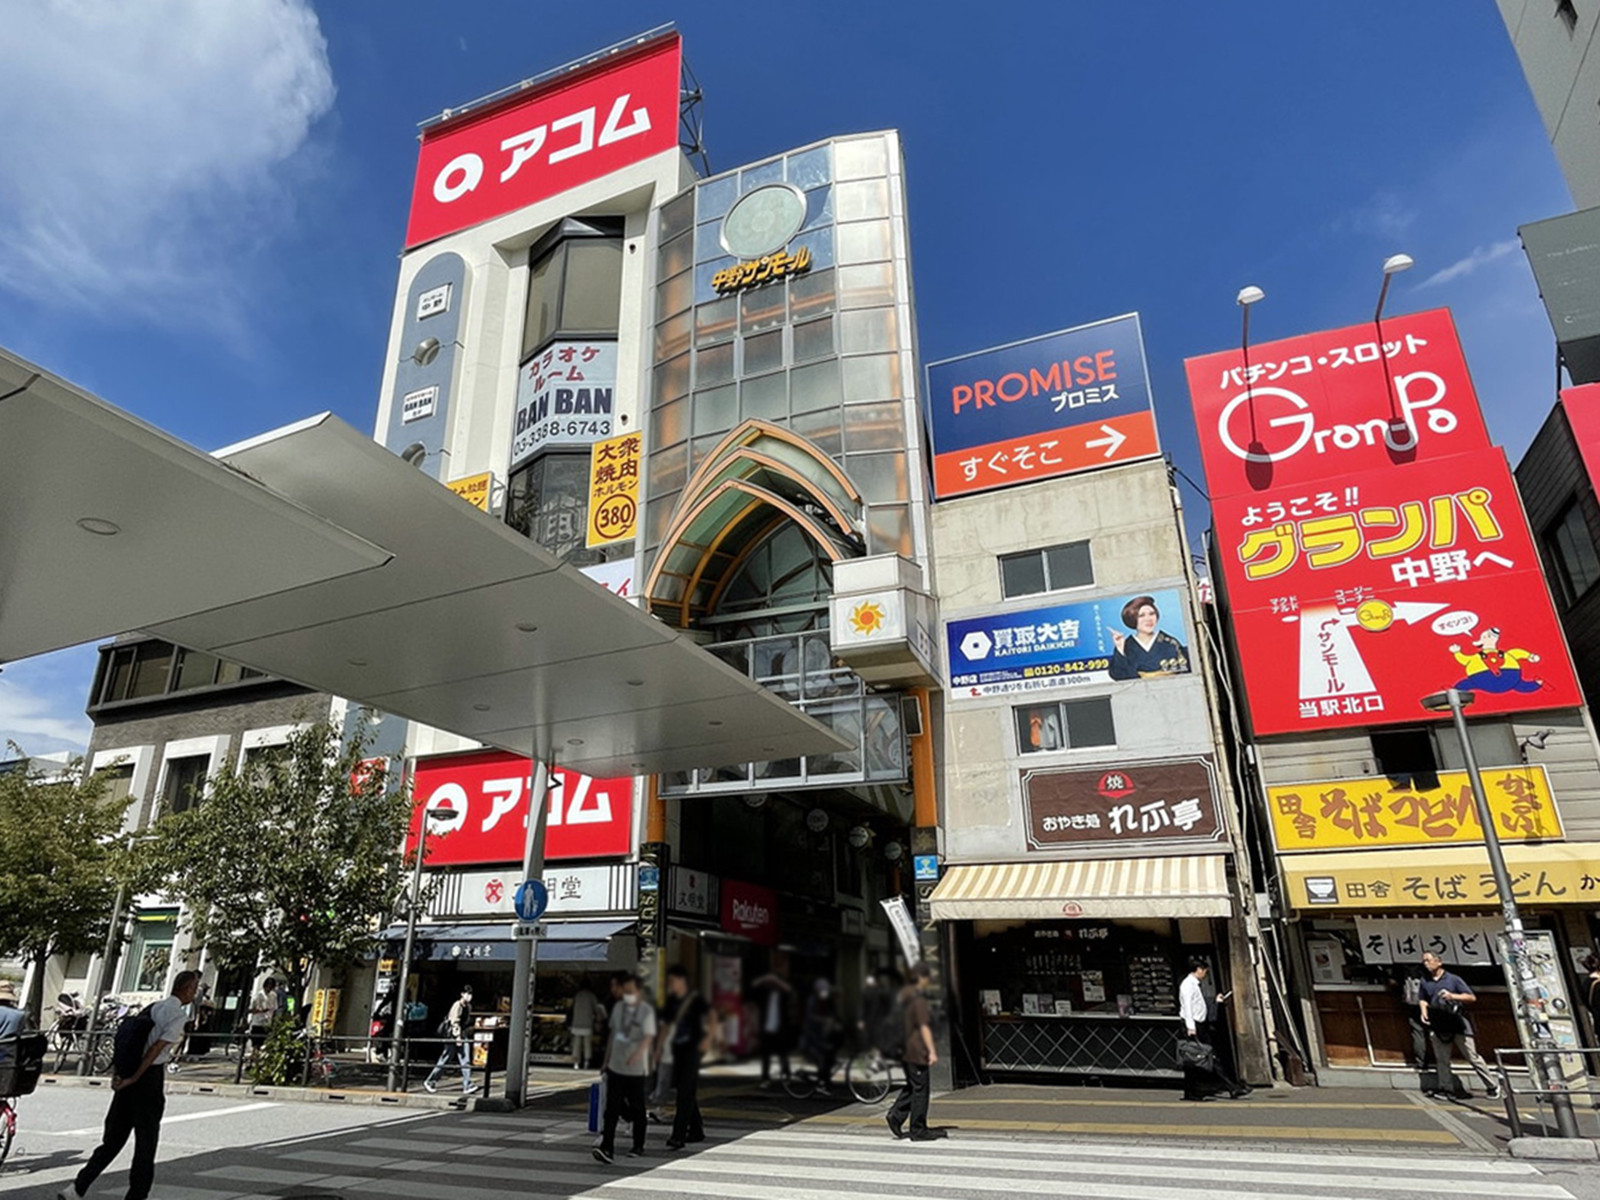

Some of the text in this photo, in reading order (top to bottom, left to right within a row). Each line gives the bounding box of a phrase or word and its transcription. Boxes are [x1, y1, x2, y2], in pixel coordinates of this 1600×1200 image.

[500, 93, 651, 183] アコム
[712, 246, 812, 292] 中野サンモール
[529, 346, 600, 379] カラオケ
[1219, 334, 1428, 390] パチンコ・スロット
[534, 365, 585, 394] ルーム
[952, 350, 1117, 415] PROMISE
[517, 388, 612, 437] BAN BAN
[1051, 383, 1120, 413] プロミス
[513, 420, 611, 456] 03-3388-6743
[597, 437, 641, 463] 大衆
[595, 458, 638, 485] 焼肉
[959, 441, 1062, 482] すぐそこ
[594, 481, 638, 497] ホルモン
[1236, 487, 1504, 581] グランパ
[1392, 550, 1514, 588] 中野へ
[1334, 586, 1373, 598] コージー
[1336, 594, 1375, 606] コーナー
[992, 619, 1080, 650] 買取大吉
[994, 639, 1075, 658] KAITORI DAIKICHI
[1317, 631, 1345, 694] サンモール
[1299, 695, 1385, 719] 当駅北口
[1042, 813, 1101, 833] おやき処
[1346, 880, 1391, 899] 田舎
[1402, 874, 1469, 900] そば
[732, 898, 770, 925] Rakuten
